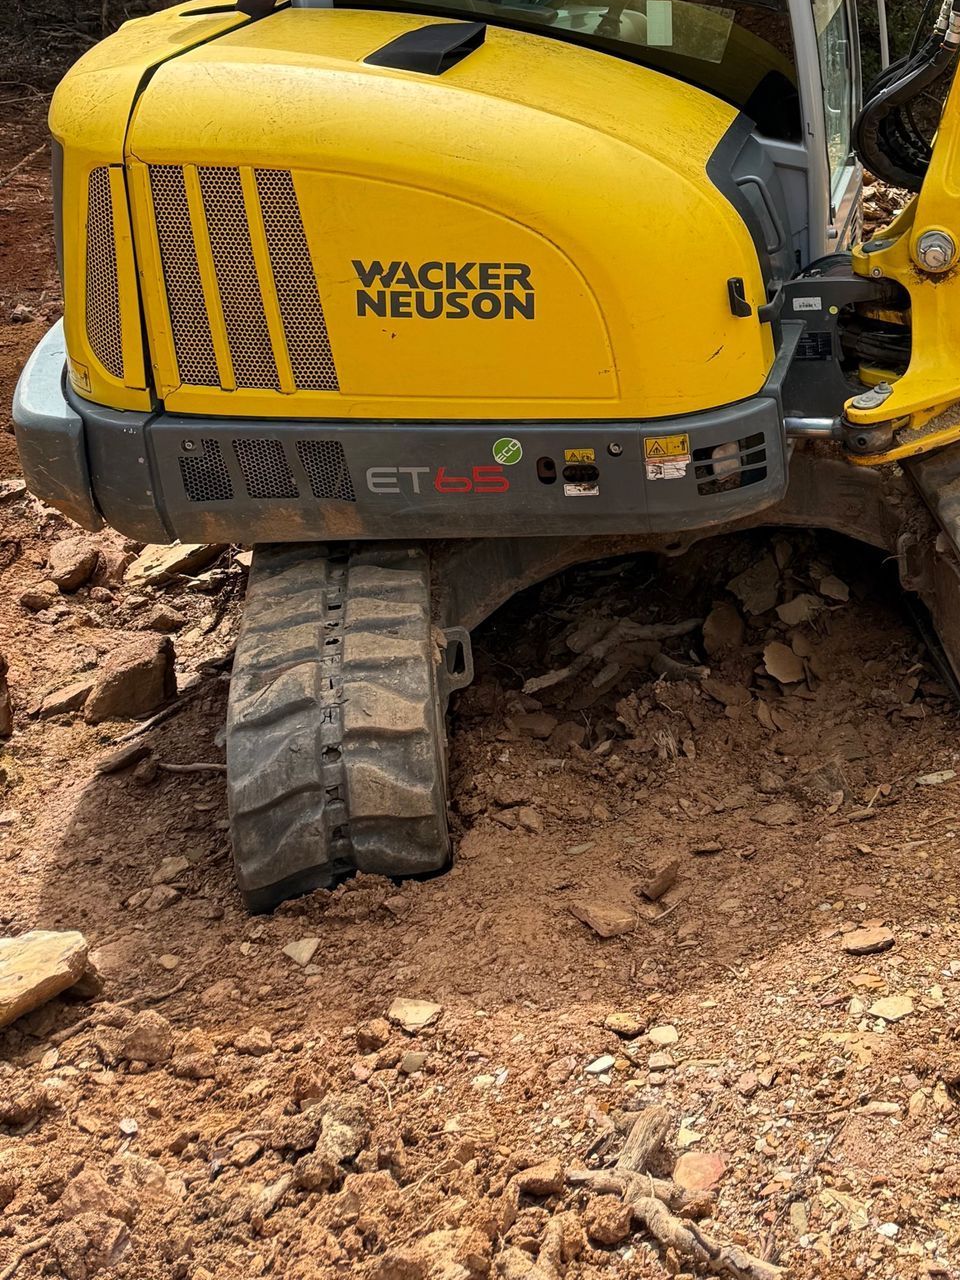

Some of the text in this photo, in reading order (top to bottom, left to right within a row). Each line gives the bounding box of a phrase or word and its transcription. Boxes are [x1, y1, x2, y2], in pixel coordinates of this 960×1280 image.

[351, 260, 535, 290] WACKER
[357, 290, 535, 320] NEUSON
[496, 439, 520, 464] ECO
